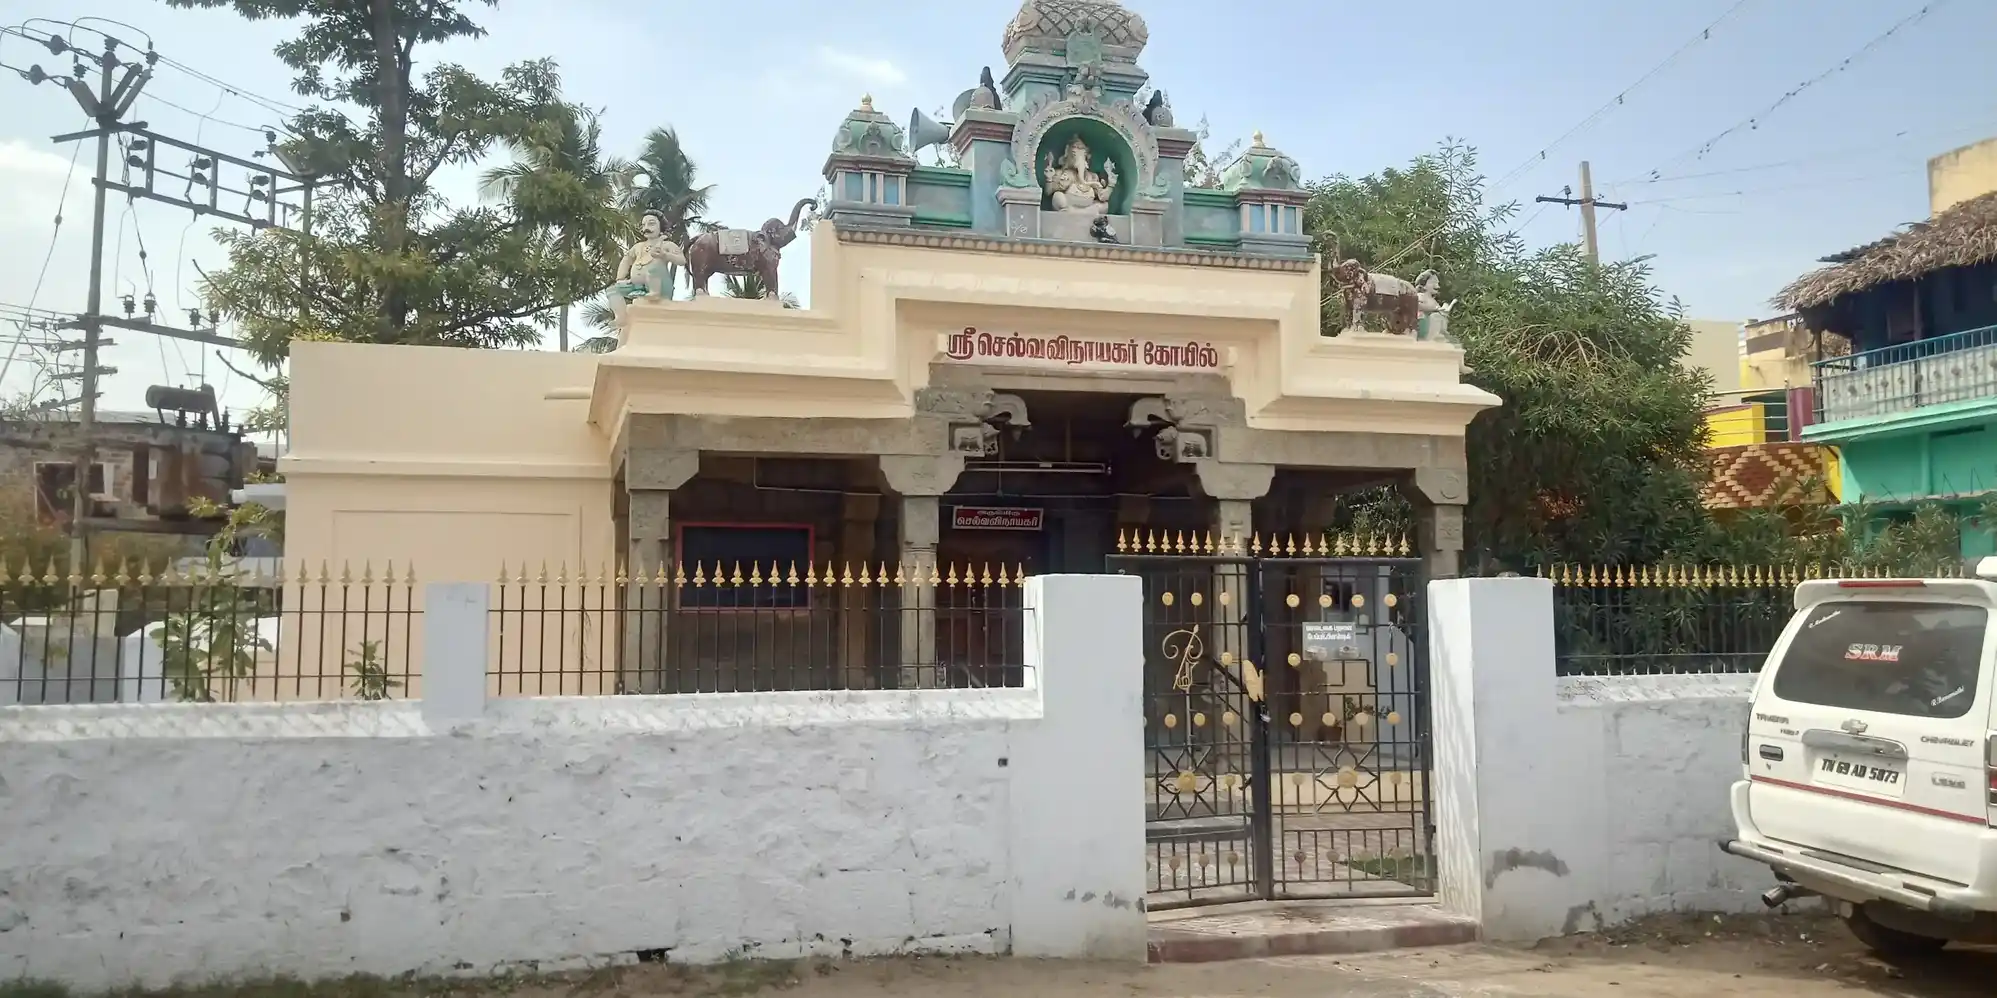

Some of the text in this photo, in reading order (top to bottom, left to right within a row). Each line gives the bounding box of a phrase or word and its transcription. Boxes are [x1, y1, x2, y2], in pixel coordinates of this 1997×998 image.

[1143, 341, 1219, 368] கோயில்
[1844, 643, 1903, 662] SRM
[1920, 735, 1975, 748] CHEVROLET
[1821, 758, 1836, 772] TN
[1836, 762, 1851, 775] 69
[1851, 764, 1867, 778] AD
